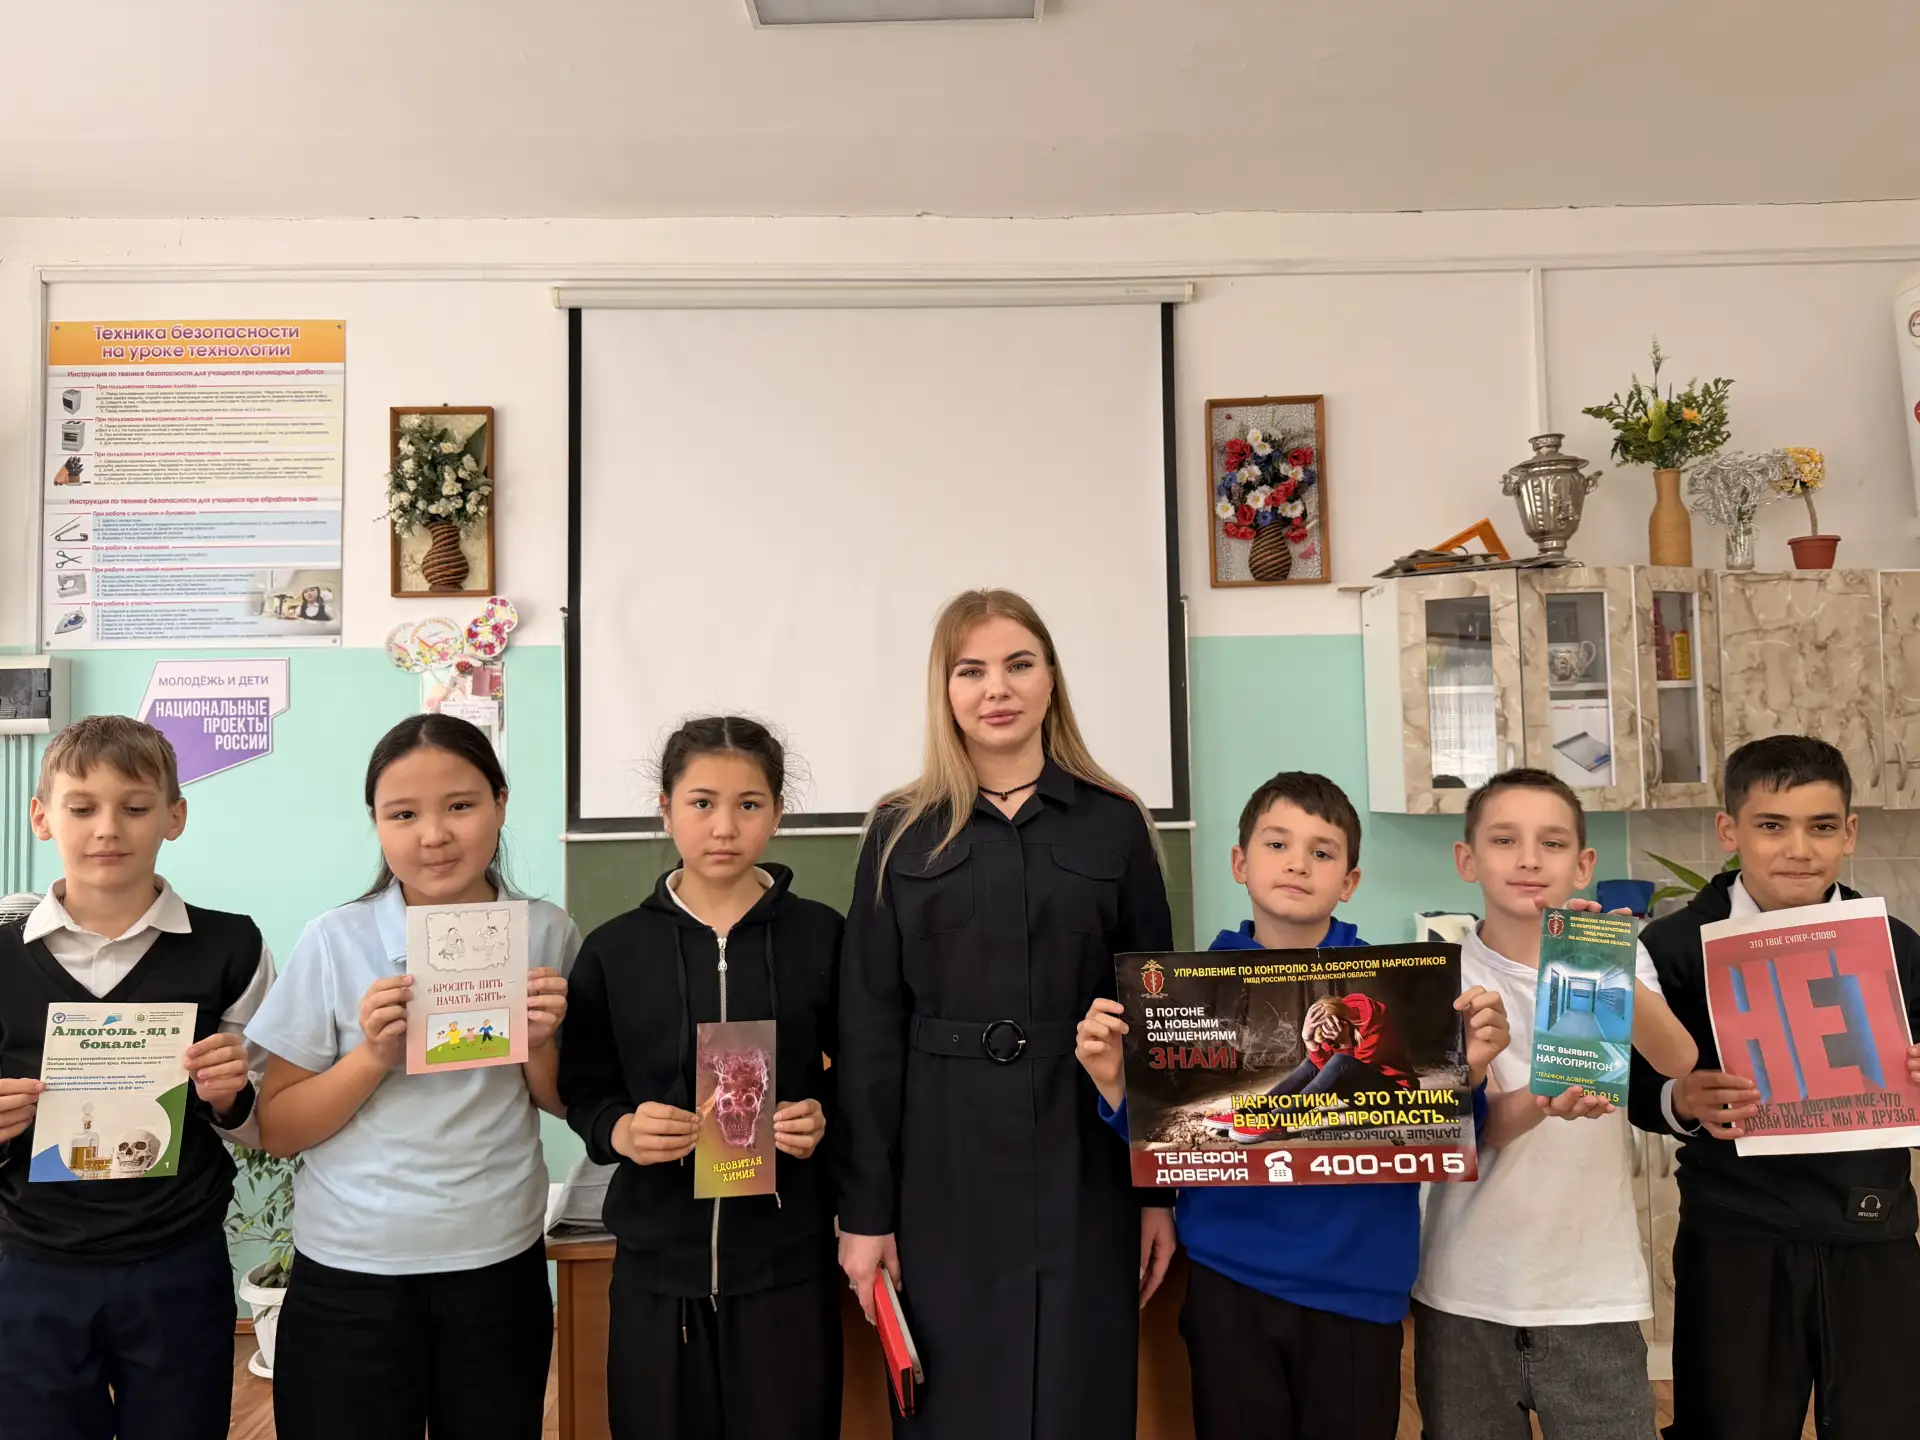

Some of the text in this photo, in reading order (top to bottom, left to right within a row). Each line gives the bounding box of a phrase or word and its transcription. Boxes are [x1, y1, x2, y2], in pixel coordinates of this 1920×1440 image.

[94, 323, 300, 340] Техника безопасности
[102, 343, 292, 361] на уроке технологии
[158, 675, 269, 687] МОЛОДЁЖЬ И ДЕТИ
[155, 700, 267, 718] НАЦИОНАЛЬНЫЕ
[203, 717, 267, 733] ПРОЕКТЫ
[215, 734, 267, 750] РОССИИ
[1750, 930, 1836, 949] ЭТО ТВОЕ СУПЕР-СЛОВО
[1173, 956, 1446, 978] УПРАВЛЕНИЕ ПО КОНТРОЛЮ ЗА ОБОРОТОМ НАРКОТИКОВ
[1297, 972, 1346, 982] АСТРАХАНСКОЙ
[1347, 971, 1376, 979] ОБЛАСТИ
[427, 981, 474, 993] «БРОСИТЬ
[436, 992, 506, 1006] НАЧАТЬ ЖИТЬ»
[1145, 1007, 1205, 1017] В ПОГОНЕ
[52, 1026, 137, 1036] Алкоголь
[171, 1027, 181, 1035] в
[1146, 1019, 1219, 1029] ЗА НОВЫМИ
[1706, 946, 1912, 1104] НЕТ
[80, 1038, 146, 1049] бокале!
[1147, 1031, 1236, 1043] ОЩУЩЕНИЯМИ
[1148, 1041, 1237, 1069] ЗНАЙ!
[1536, 1053, 1613, 1072] НАРКОПРИТОН
[1231, 1093, 1338, 1109] НАРКОТИКИ
[1353, 1091, 1390, 1106] ЭТО
[1394, 1089, 1459, 1106] ТУПИК,
[1580, 1089, 1619, 1103] 00-015
[1777, 1101, 1800, 1118] ТУТ
[1802, 1095, 1853, 1115] ДОСТАЛИ
[1855, 1092, 1904, 1108] КОЕ-ЧТО.
[1233, 1108, 1460, 1129] ВЕДУЩИЙ В ПРОПАСТЬ...
[1744, 1107, 1919, 1133] ДАВАЙ ВМЕСТЕ, МЫ Ж ДРУЗЬЯ.
[1300, 1127, 1461, 1141] ДАЛЬШЕ ТОЛЬКО СМЕРТЬ
[165, 1161, 170, 1169] 1
[713, 1155, 763, 1172] ЯДОВИТАЯ
[1154, 1151, 1247, 1164] ТЕЛЕФОН
[1310, 1153, 1464, 1175] 400-015
[722, 1168, 756, 1182] ХИМИЯ
[1156, 1168, 1248, 1184] ДОВЕРИЯ
